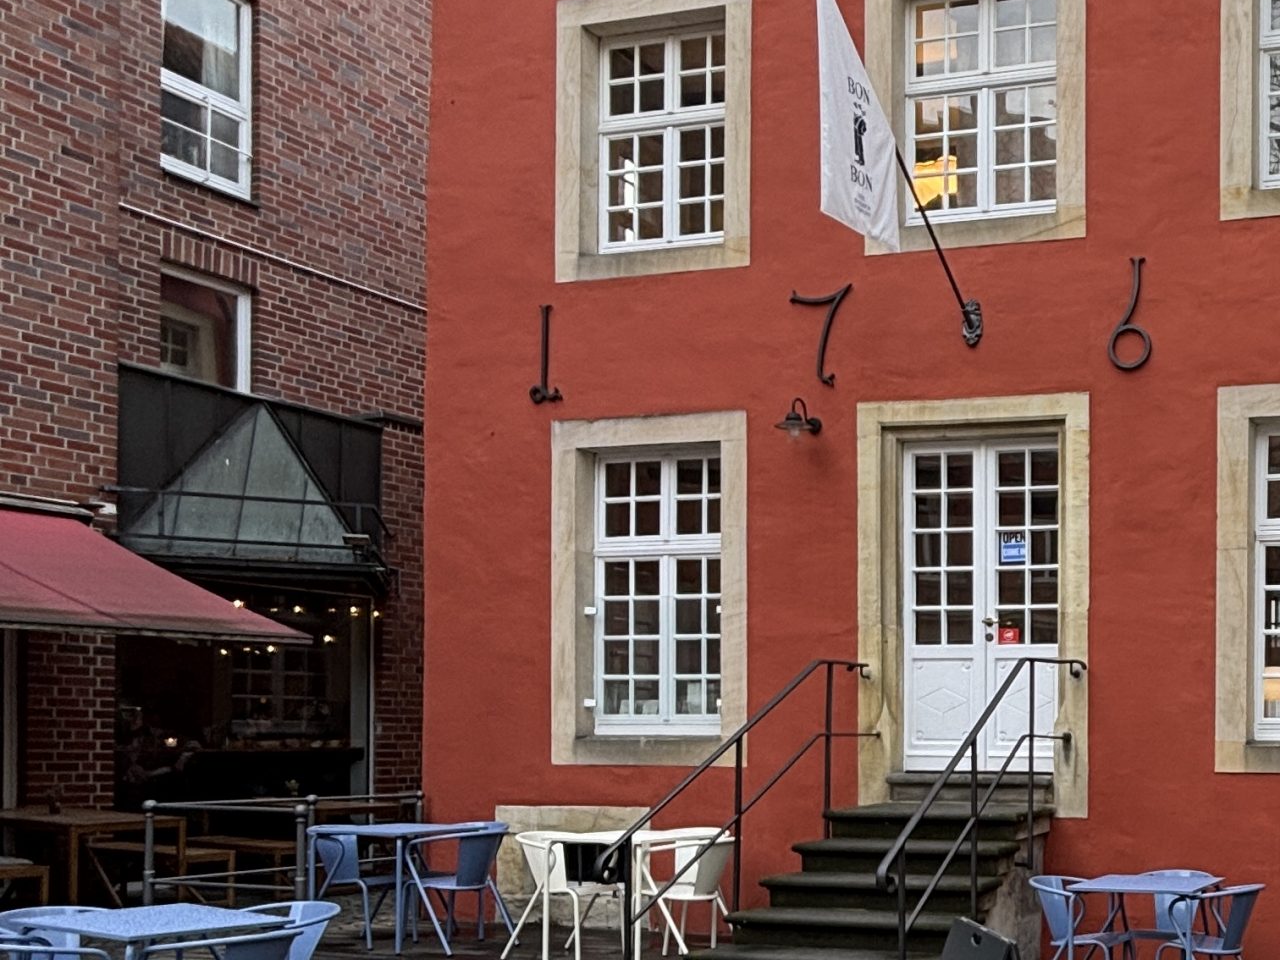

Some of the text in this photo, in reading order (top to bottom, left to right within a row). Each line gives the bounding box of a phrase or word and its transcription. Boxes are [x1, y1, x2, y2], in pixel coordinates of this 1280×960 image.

[847, 76, 871, 106] BON
[850, 165, 873, 193] BON
[789, 283, 853, 390] 7
[1108, 256, 1153, 377] 6
[1002, 531, 1025, 544] OPEN
